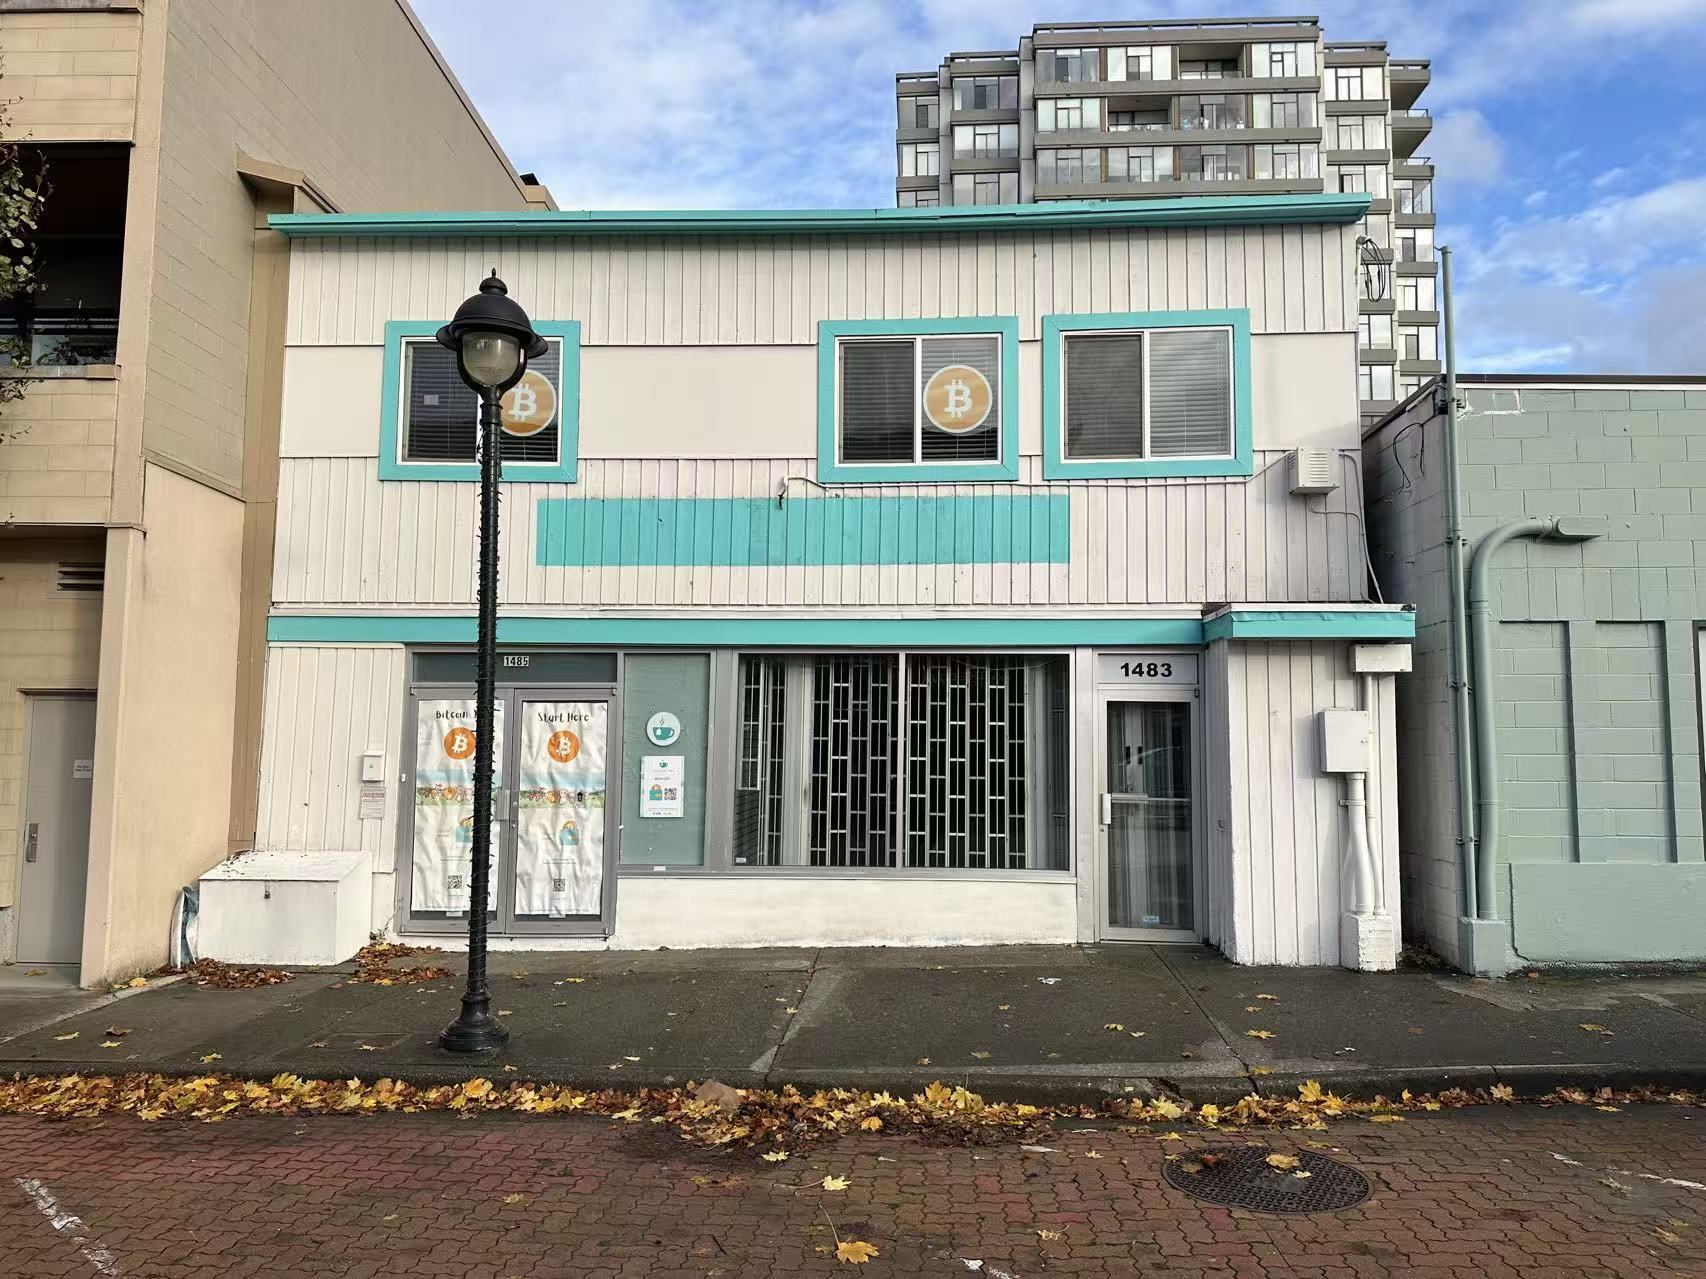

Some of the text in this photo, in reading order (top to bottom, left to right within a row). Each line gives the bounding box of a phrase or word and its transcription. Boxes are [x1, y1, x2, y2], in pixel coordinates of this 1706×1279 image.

[505, 656, 528, 666] 1485
[1120, 662, 1173, 677] 1483
[538, 712, 590, 723] Start Here
